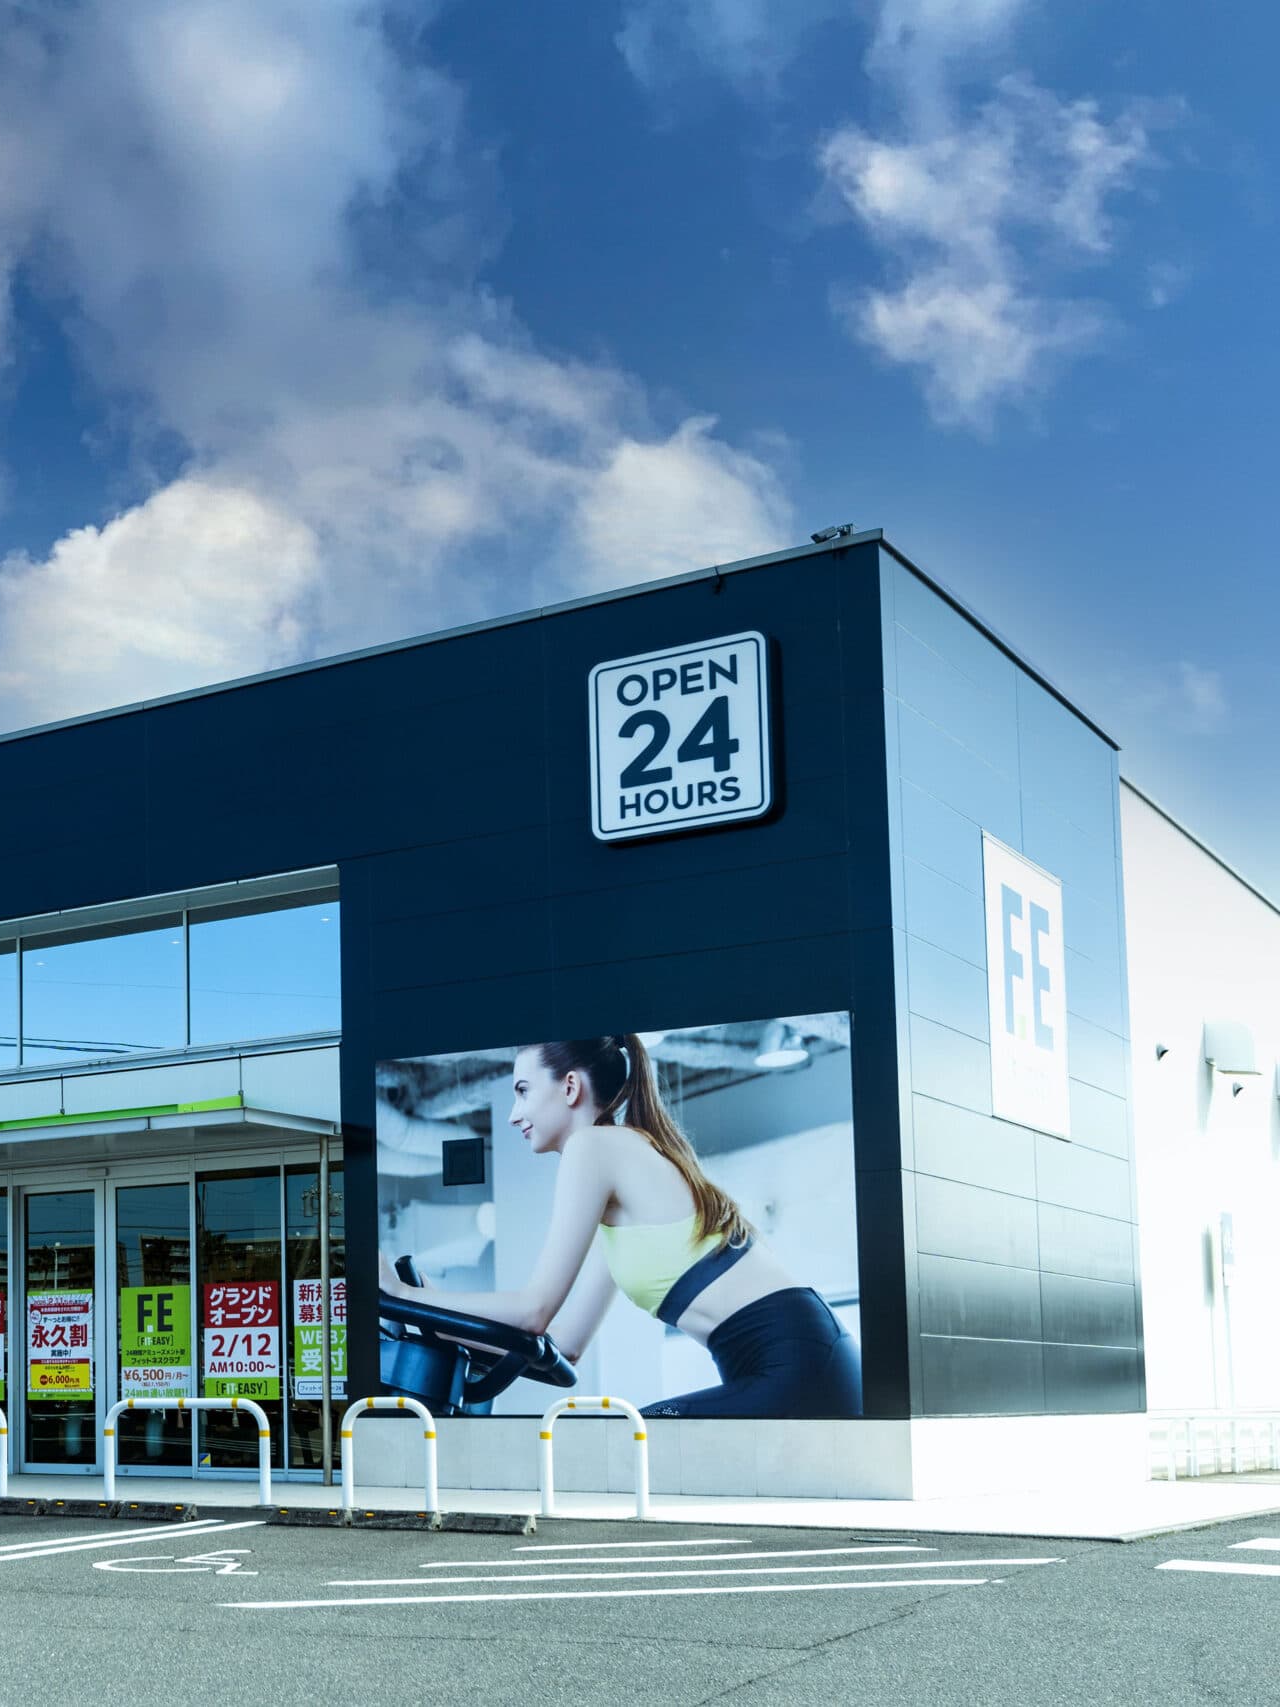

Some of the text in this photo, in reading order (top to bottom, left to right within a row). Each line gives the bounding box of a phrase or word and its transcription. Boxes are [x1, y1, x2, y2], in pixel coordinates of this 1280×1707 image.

[616, 653, 738, 706] OPEN
[618, 695, 740, 789] 24
[619, 776, 741, 819] HOURS
[210, 1285, 272, 1306] グランド
[210, 1305, 273, 1326] オープン
[31, 1324, 88, 1349] 永久割
[211, 1333, 272, 1358] 2/12
[131, 1356, 181, 1365] フィットネスクラブ
